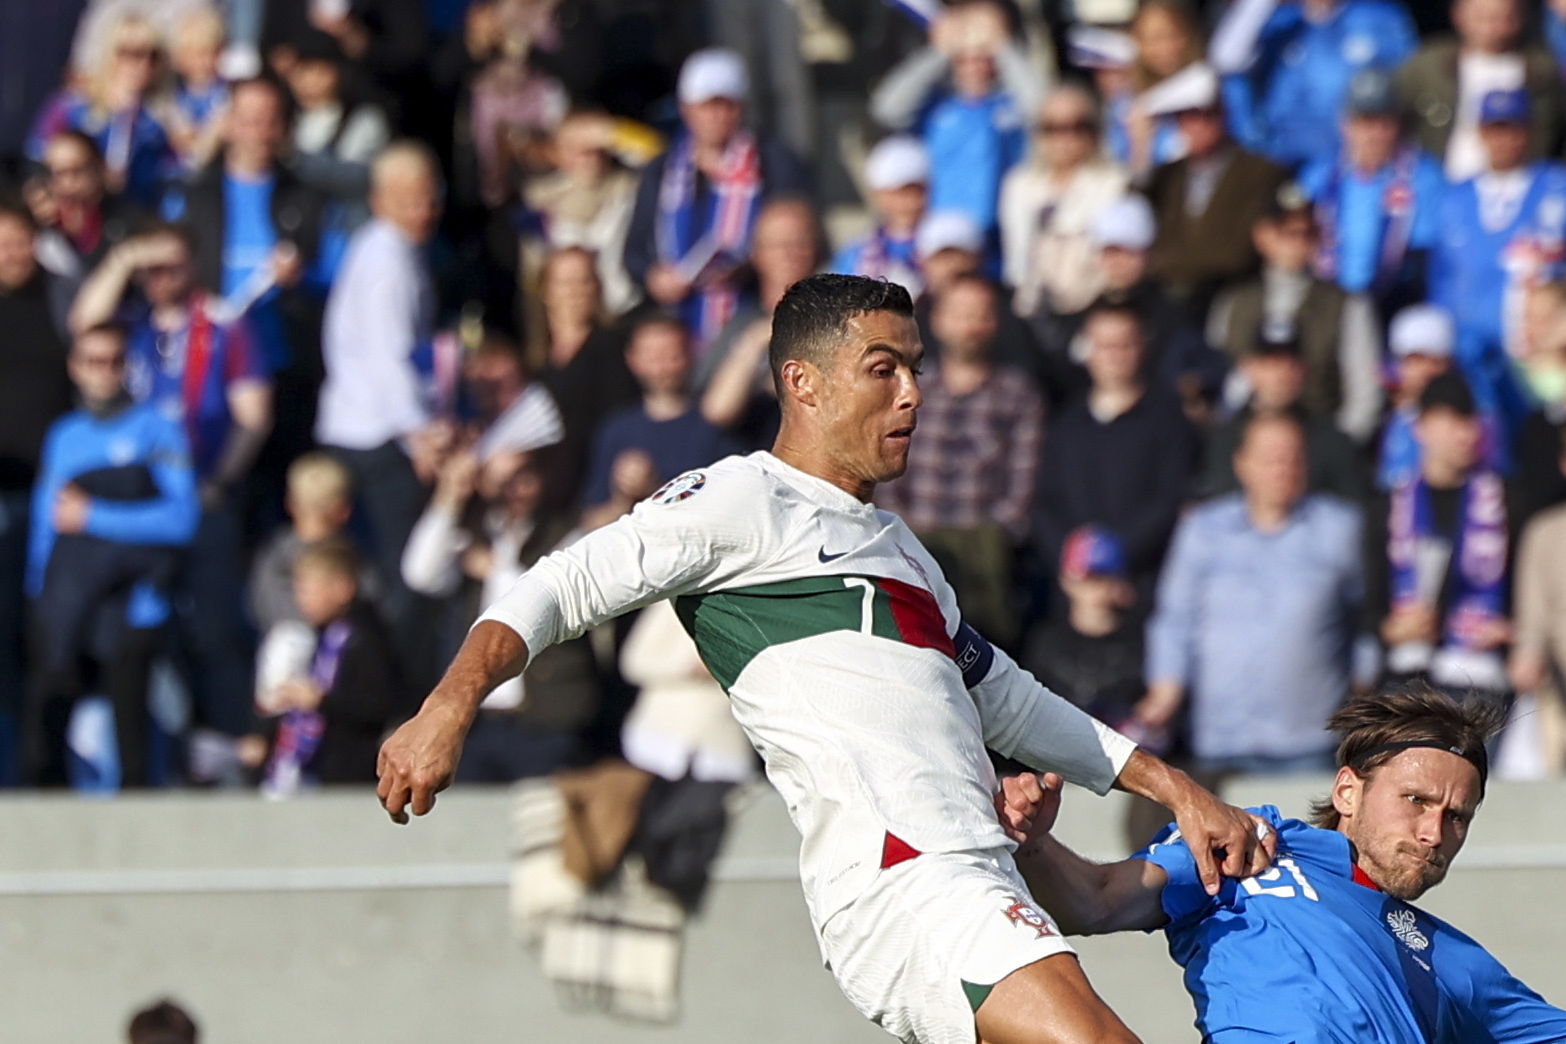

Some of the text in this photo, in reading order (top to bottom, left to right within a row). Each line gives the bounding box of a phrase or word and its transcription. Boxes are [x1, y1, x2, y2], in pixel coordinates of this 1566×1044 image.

[843, 577, 875, 636] 7
[957, 644, 978, 670] ECT
[1241, 858, 1319, 901] 21
